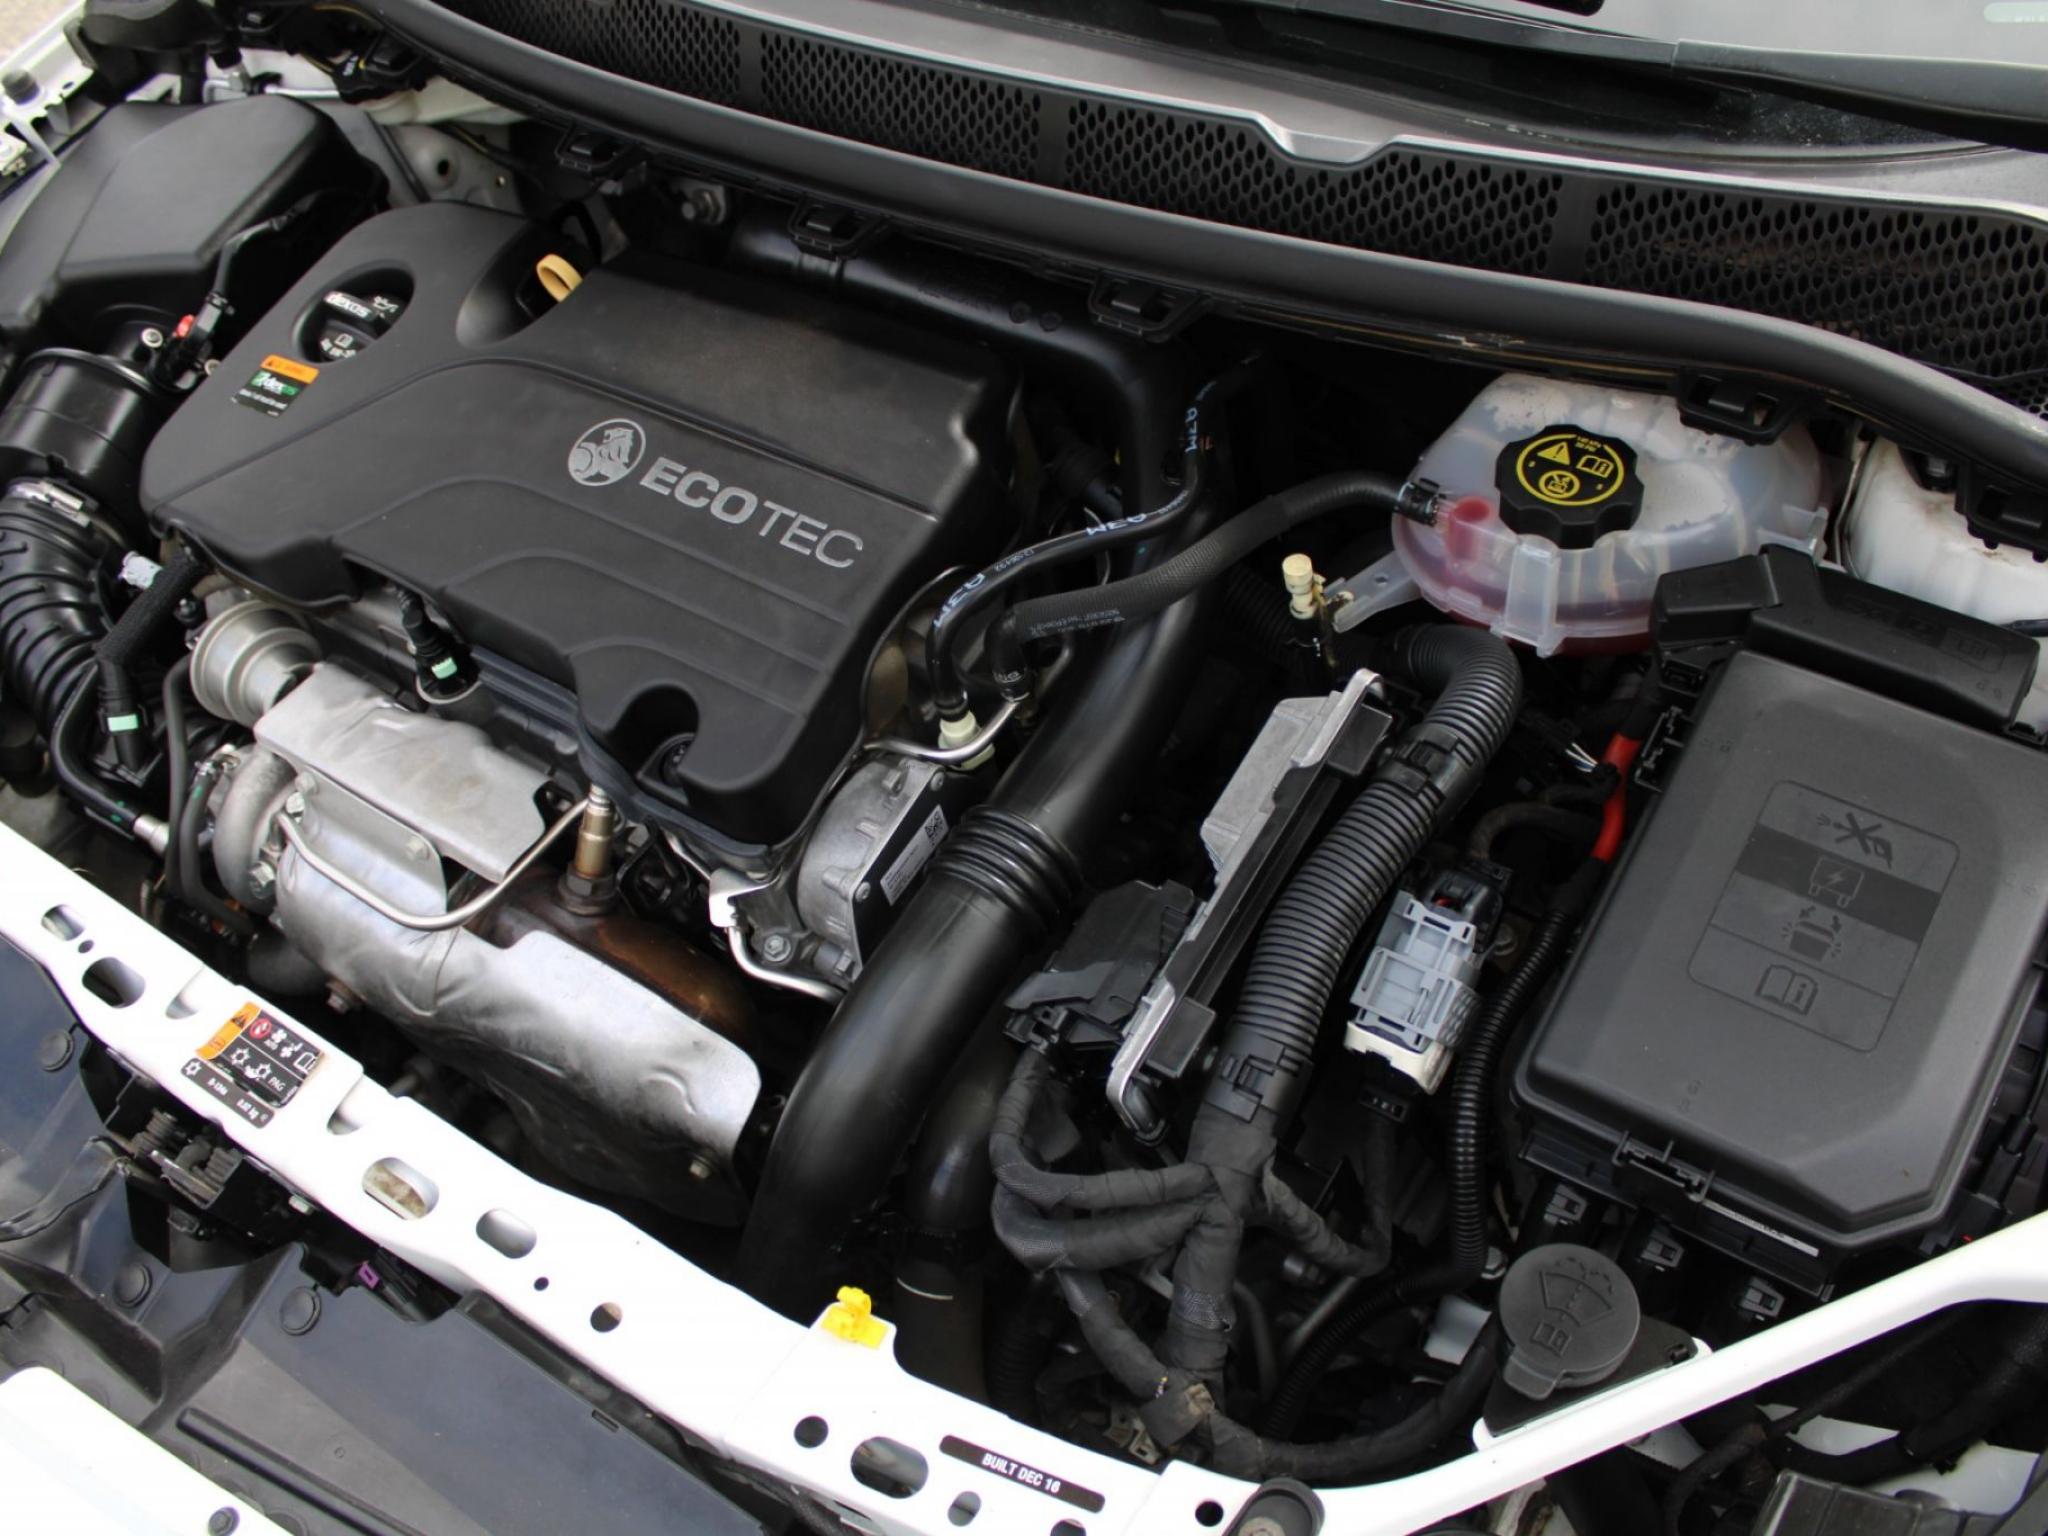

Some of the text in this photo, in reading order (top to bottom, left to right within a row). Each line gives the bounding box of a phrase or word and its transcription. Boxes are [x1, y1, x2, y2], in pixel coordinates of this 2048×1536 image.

[639, 456, 864, 568] ECOTEC
[268, 1077, 287, 1092] PAG
[982, 1453, 1018, 1476] BUILT
[1017, 1466, 1043, 1487] DEC
